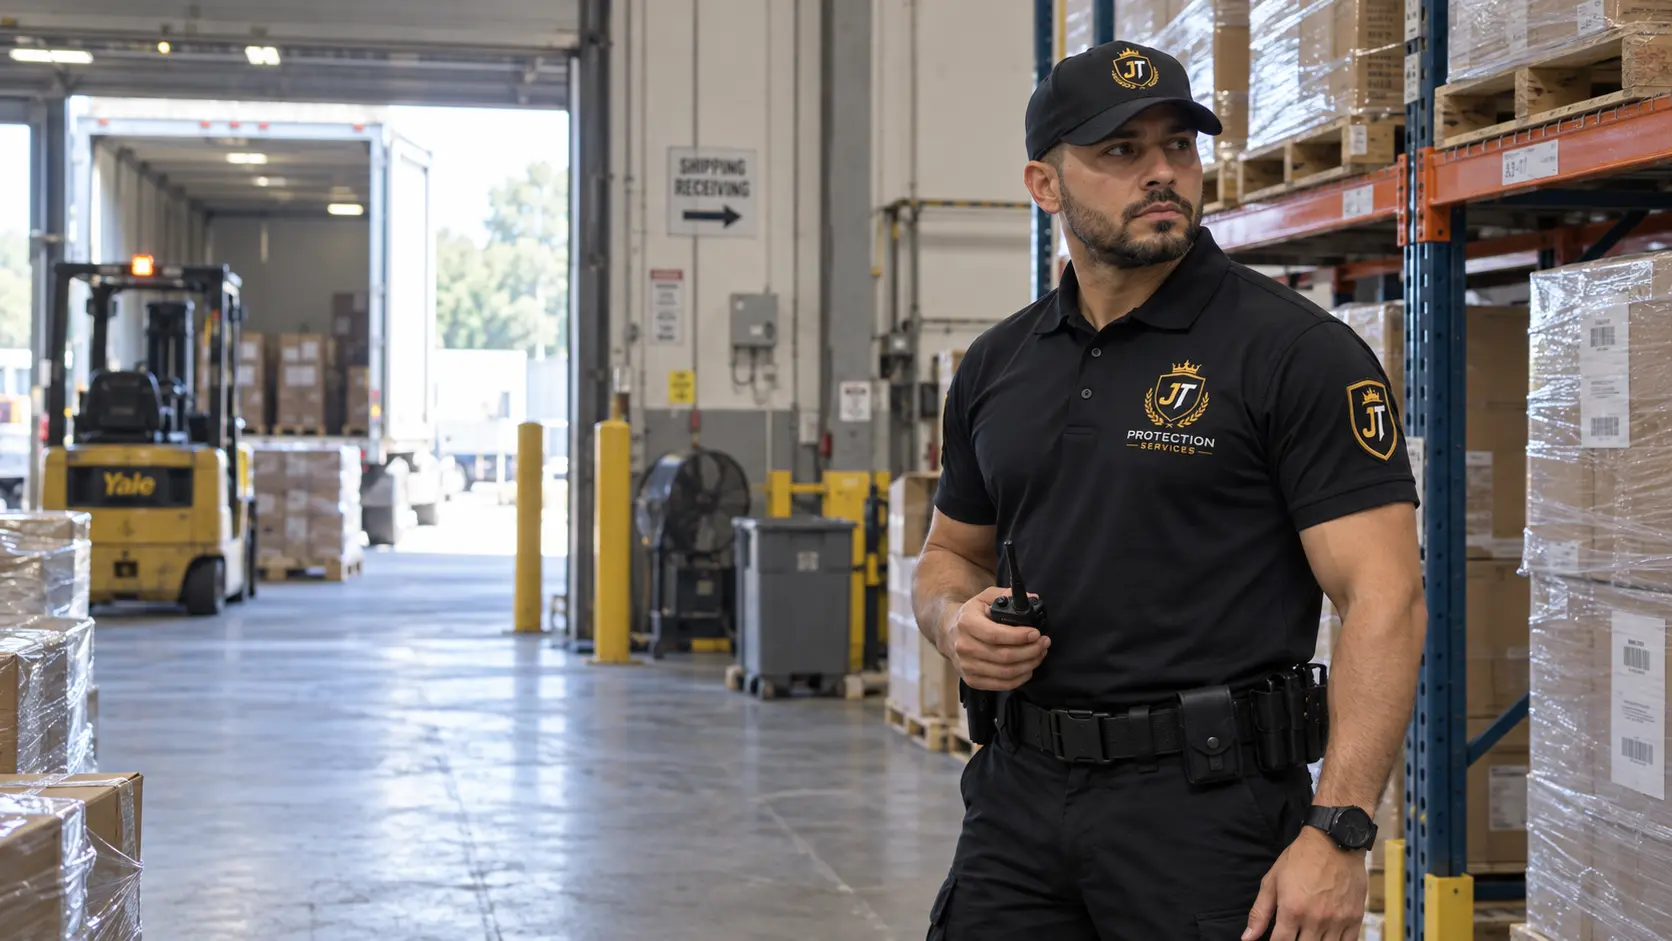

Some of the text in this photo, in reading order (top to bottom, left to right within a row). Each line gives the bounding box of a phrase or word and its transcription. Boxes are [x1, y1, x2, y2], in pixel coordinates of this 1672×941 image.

[1124, 61, 1145, 79] JT
[680, 158, 746, 175] SHIPPING
[674, 179, 750, 198] RECEIVING
[1159, 382, 1198, 410] JT
[1362, 405, 1385, 441] JT
[1126, 430, 1215, 447] PROTECTION
[1140, 442, 1196, 455] SERVICES
[104, 472, 156, 496] Yale
